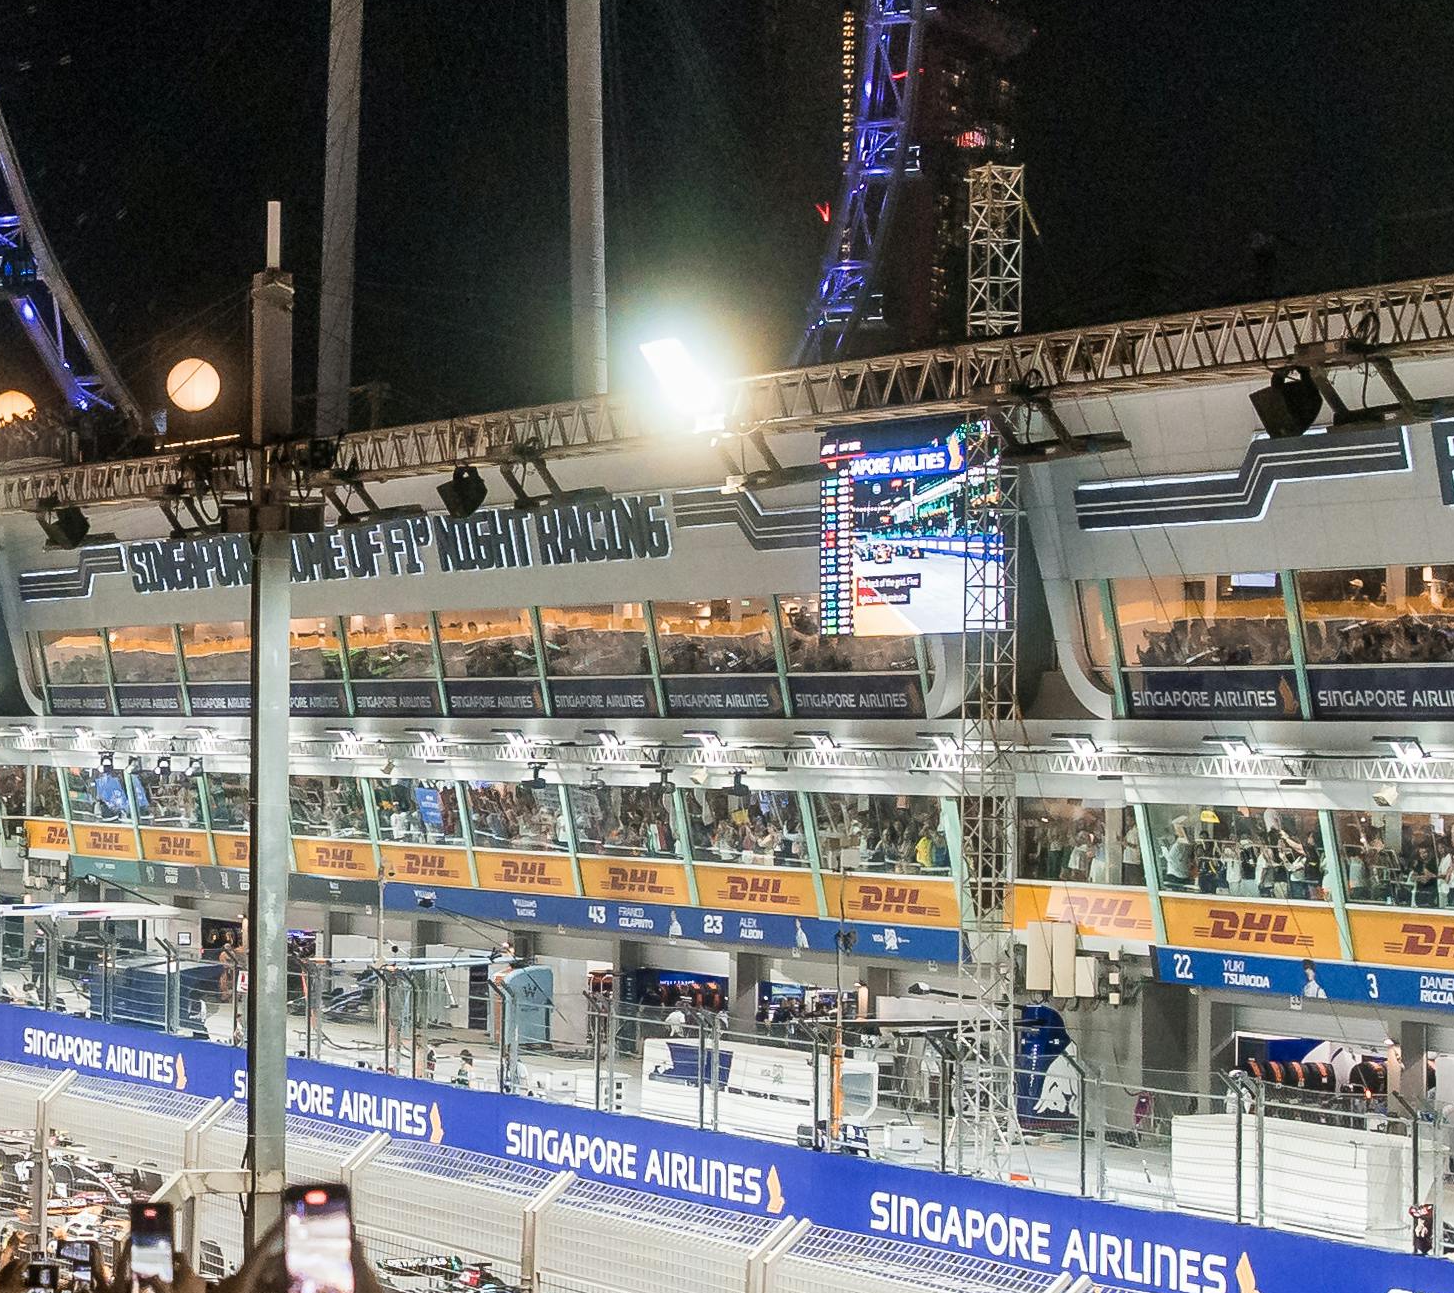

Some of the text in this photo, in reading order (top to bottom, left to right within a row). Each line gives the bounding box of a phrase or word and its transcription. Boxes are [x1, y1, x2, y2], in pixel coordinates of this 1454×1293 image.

[128, 534, 253, 594] SINGAPOR
[290, 529, 351, 584] OME
[434, 510, 534, 573] NIGHT
[535, 494, 674, 567] RACING
[227, 697, 251, 709] AIRLINE
[555, 694, 645, 708] SINGAPORE AIRLINES
[668, 693, 770, 708] SINGAPORE AIRLINES
[795, 692, 908, 708] SINGAPORE AIRLINES
[1132, 690, 1277, 707] SINGAPORE AIRLINES
[1318, 689, 1407, 707] SINGAPORE
[316, 848, 358, 871] DHL
[403, 853, 447, 877] DHL
[502, 860, 548, 885] DHL
[608, 867, 664, 893] DHL
[727, 876, 788, 904] DHL
[858, 885, 927, 916] DHL
[588, 905, 606, 923] 43
[703, 914, 757, 934] 23 ALEX
[1059, 895, 1137, 930] DHL
[739, 927, 764, 940] ALBON
[1207, 909, 1297, 946] DHL
[1173, 954, 1244, 979] 22 YUKI
[1222, 972, 1270, 989] TSUNODA
[1366, 973, 1379, 998] 3
[23, 1027, 174, 1085] SINGAPORE AIRLINES
[338, 1089, 427, 1137] AIRLINES
[505, 1122, 762, 1205] SINGAPORE AIRLINES
[870, 1191, 1052, 1264] SINGAPORE
